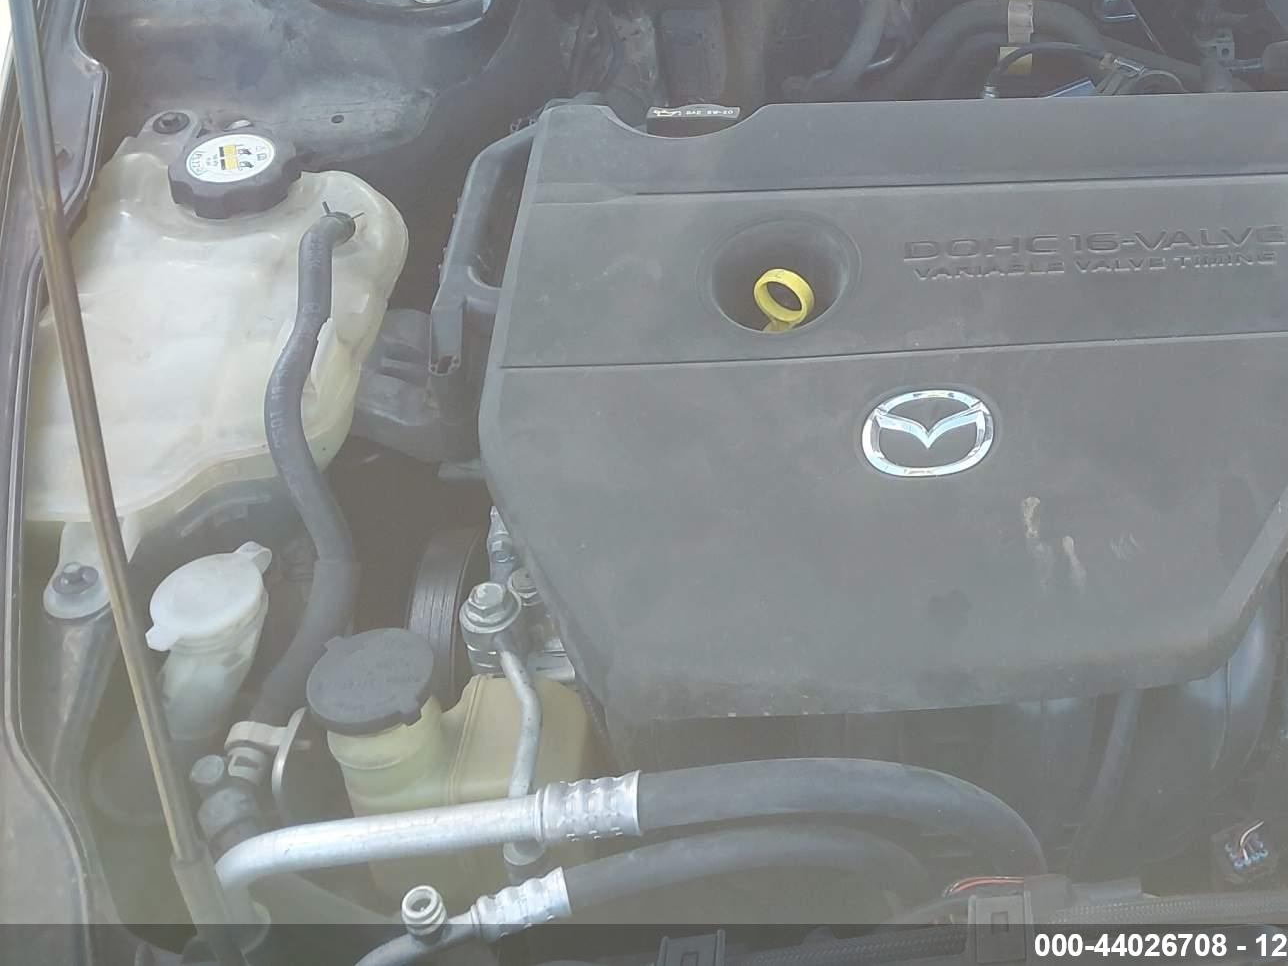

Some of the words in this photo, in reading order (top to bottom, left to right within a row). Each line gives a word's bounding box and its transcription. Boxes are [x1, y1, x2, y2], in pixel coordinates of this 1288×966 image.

[904, 235, 1060, 262] DOHC
[1069, 225, 1287, 253] 16-VALVE
[914, 261, 1064, 280] VARIABLE
[1075, 257, 1167, 273] VALVE
[1173, 251, 1278, 267] TIMING
